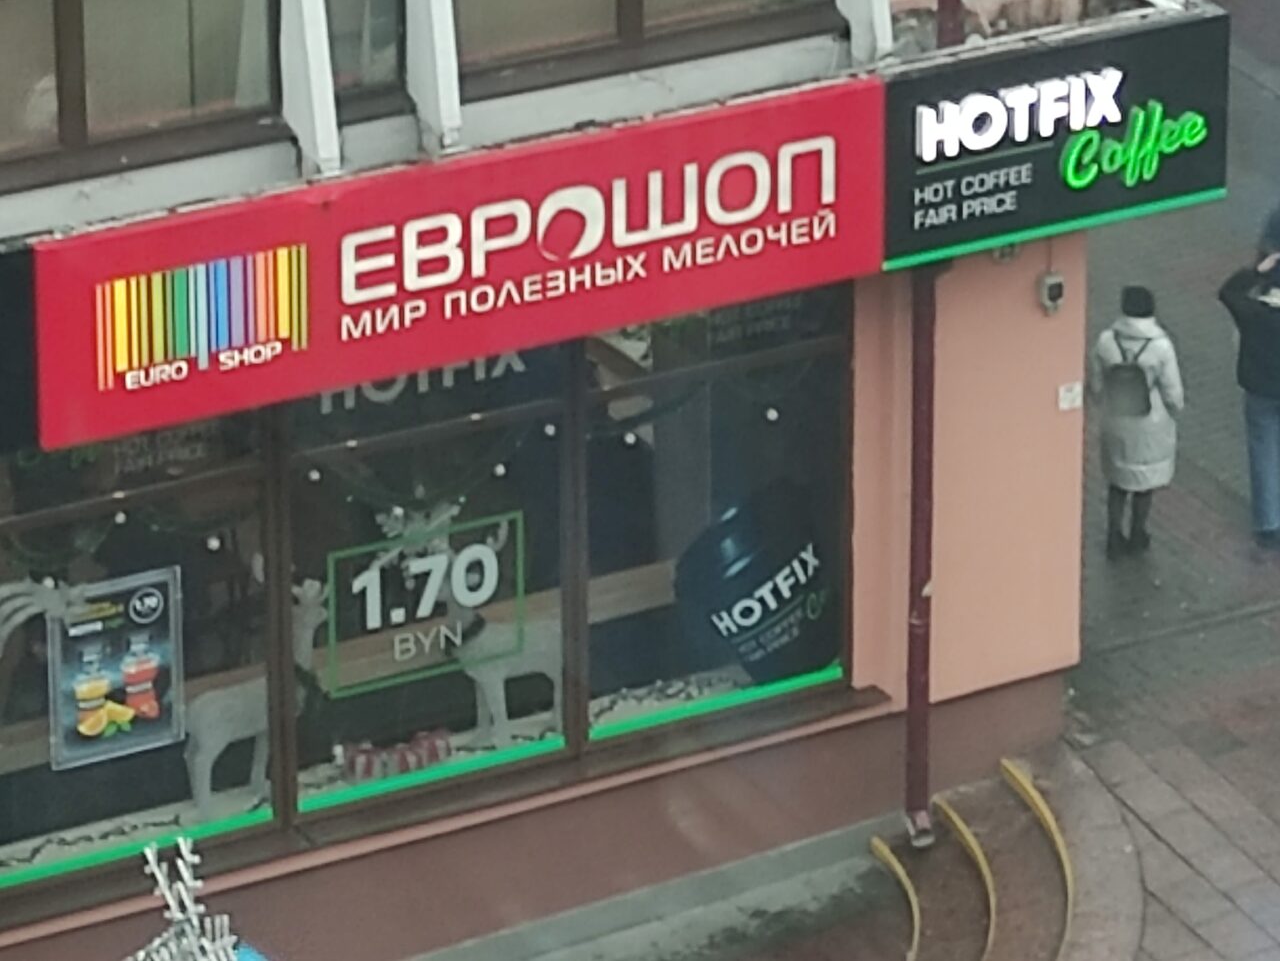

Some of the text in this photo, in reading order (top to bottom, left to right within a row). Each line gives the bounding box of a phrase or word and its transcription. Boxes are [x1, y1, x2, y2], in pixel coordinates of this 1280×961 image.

[916, 66, 1123, 162] HOTFIX
[1060, 99, 1207, 188] Coffee
[340, 135, 837, 306] ЕВРОШОП
[914, 163, 1032, 206] HOT COFFEE
[914, 191, 1017, 230] FAIR PRICE
[341, 298, 427, 342] МИР
[444, 251, 647, 320] ПОЛЕЗНЫХ
[662, 208, 837, 273] МЕЛОЧЕЙ
[125, 340, 283, 390] EURO SHOP
[351, 543, 499, 631] 1.70
[711, 542, 819, 637] HOTFIX
[393, 620, 463, 661] BYN
